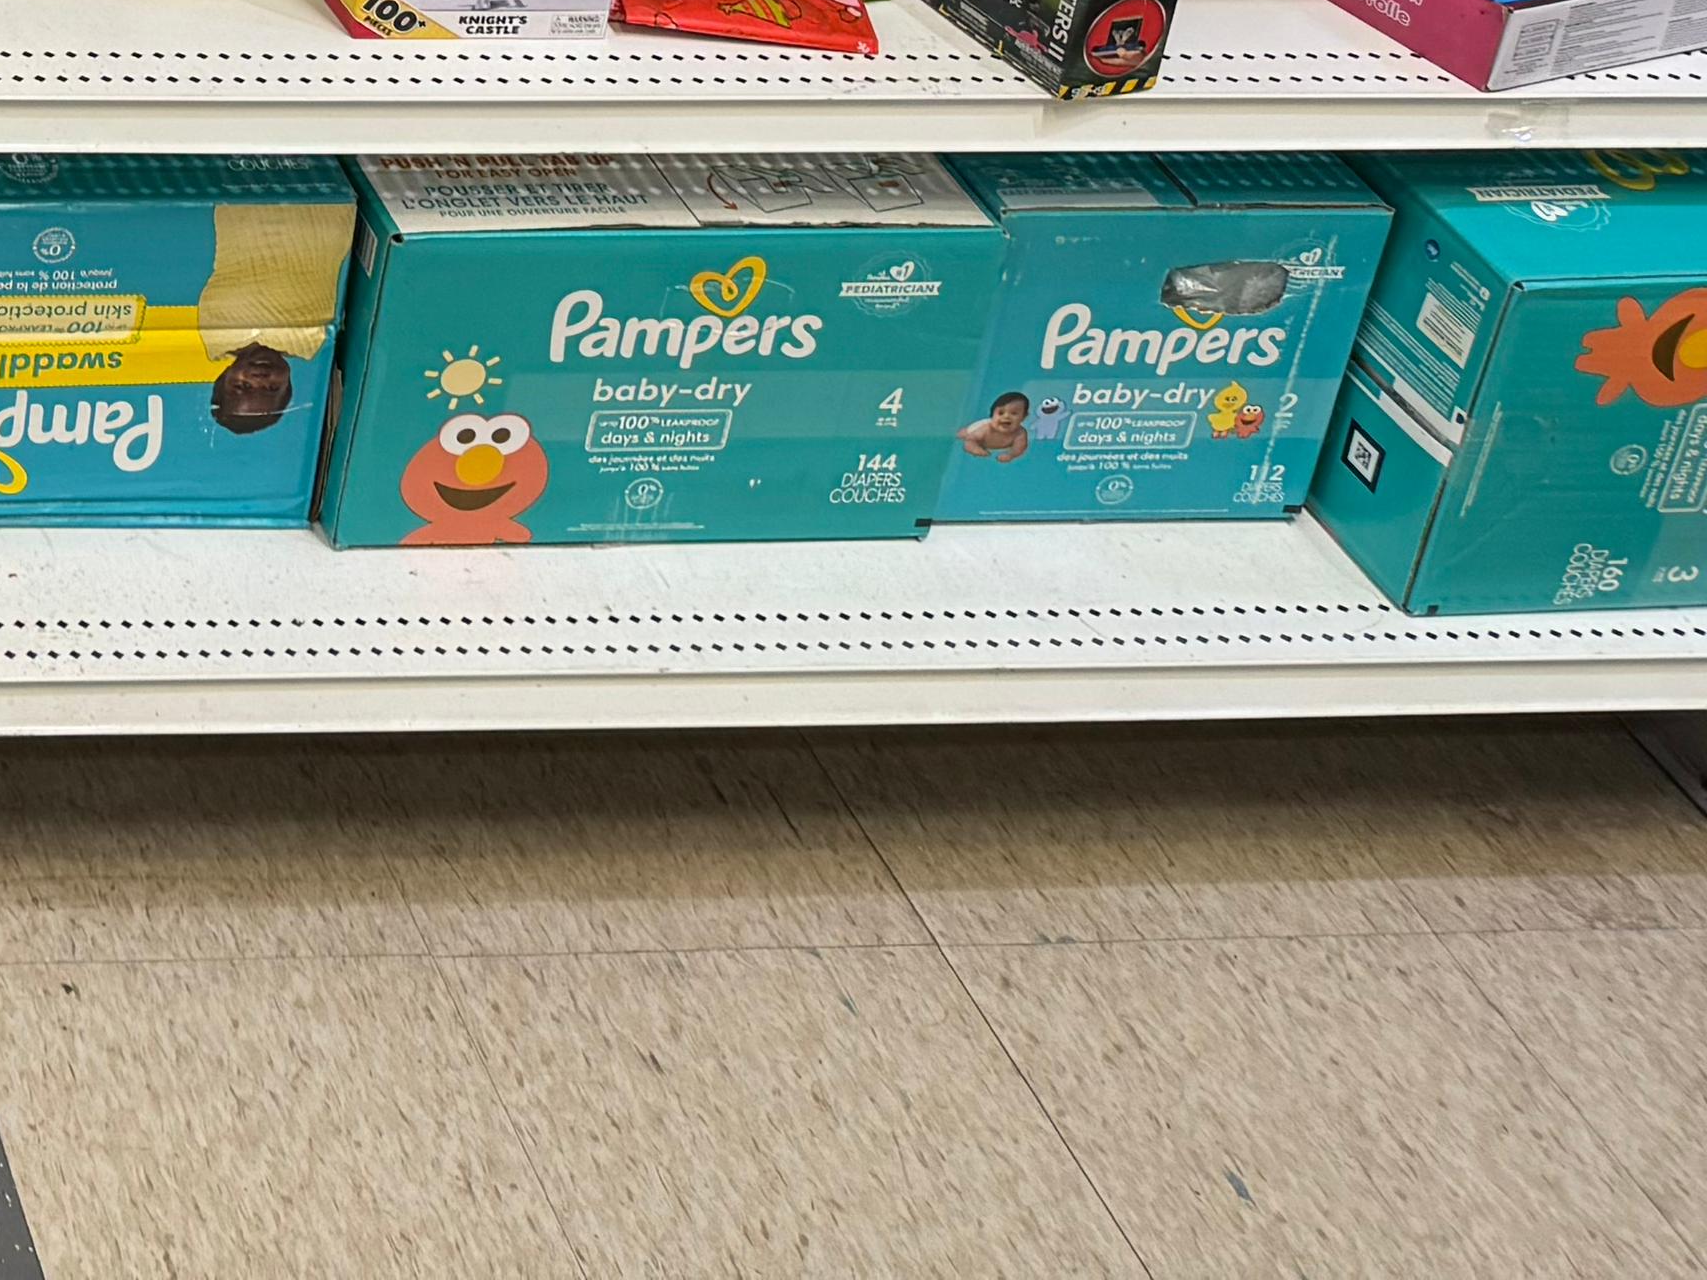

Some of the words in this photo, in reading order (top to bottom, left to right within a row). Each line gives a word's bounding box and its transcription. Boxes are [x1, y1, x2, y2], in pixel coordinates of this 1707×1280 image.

[459, 16, 527, 24] KNIGHT'S
[466, 26, 519, 34] CASTLE
[94, 304, 131, 318] skin
[549, 289, 823, 369] Pampers
[1041, 304, 1285, 375] Pampers
[593, 377, 751, 407] baby-dry
[1073, 383, 1215, 409] baby-dry
[879, 388, 903, 414] 4
[601, 432, 638, 446] days
[643, 433, 654, 444] &
[660, 432, 710, 447] nights
[1078, 433, 1112, 444] days
[1117, 433, 1126, 443] &
[1131, 432, 1176, 445] nights
[857, 454, 896, 471] 144
[842, 473, 902, 486] DIAPERS
[829, 488, 906, 503] COUCHES
